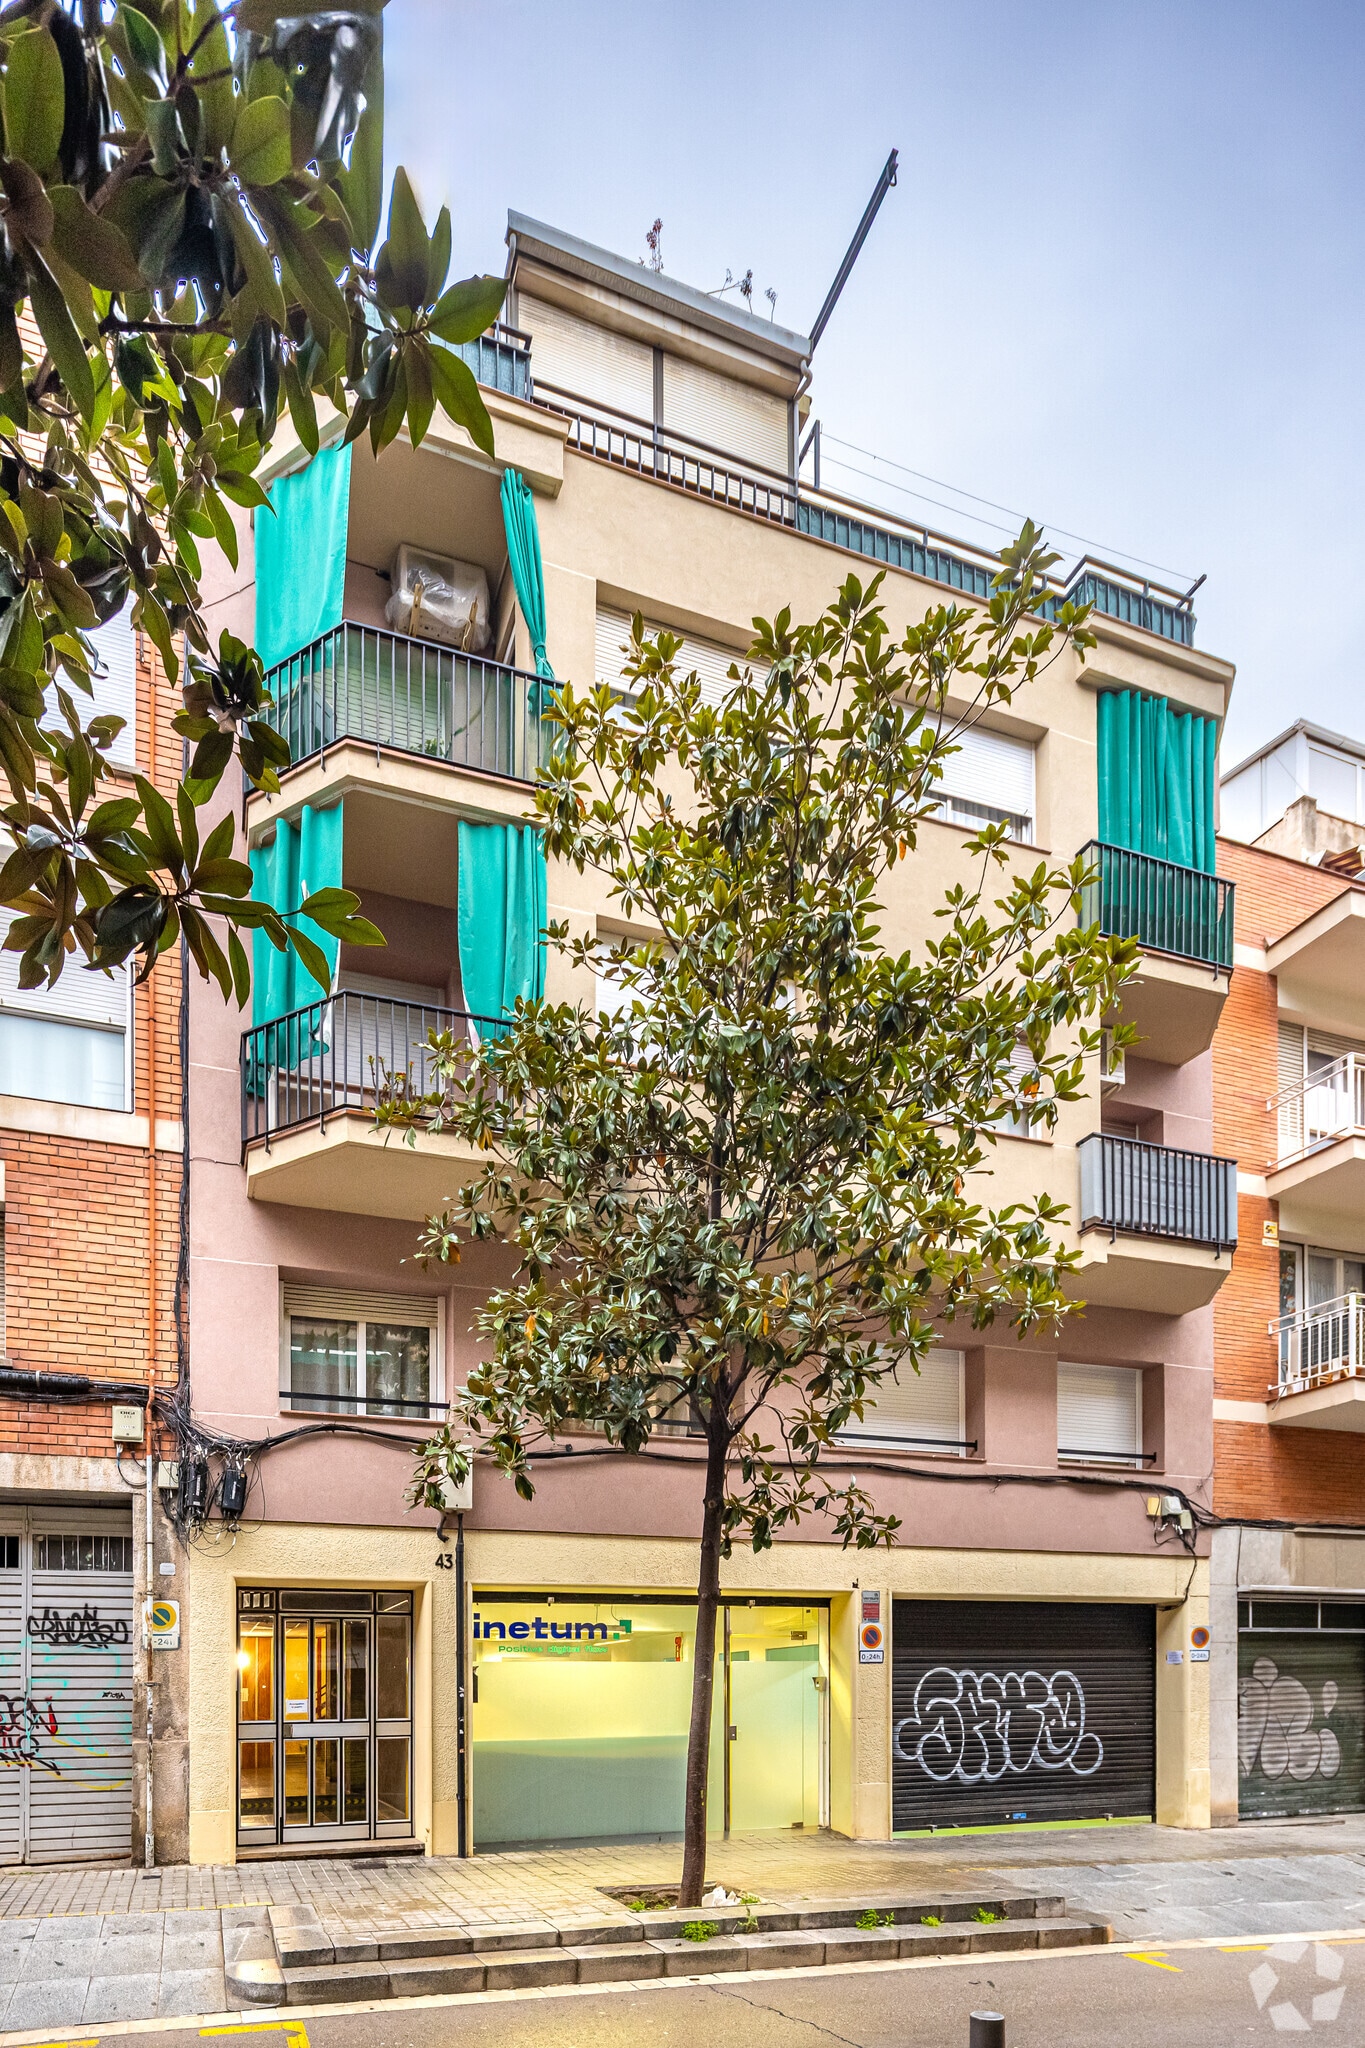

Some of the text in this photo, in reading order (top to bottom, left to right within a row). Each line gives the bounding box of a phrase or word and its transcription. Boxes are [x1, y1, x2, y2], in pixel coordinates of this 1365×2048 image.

[435, 1553, 453, 1569] 43
[498, 1645, 608, 1655] Positive digital flow
